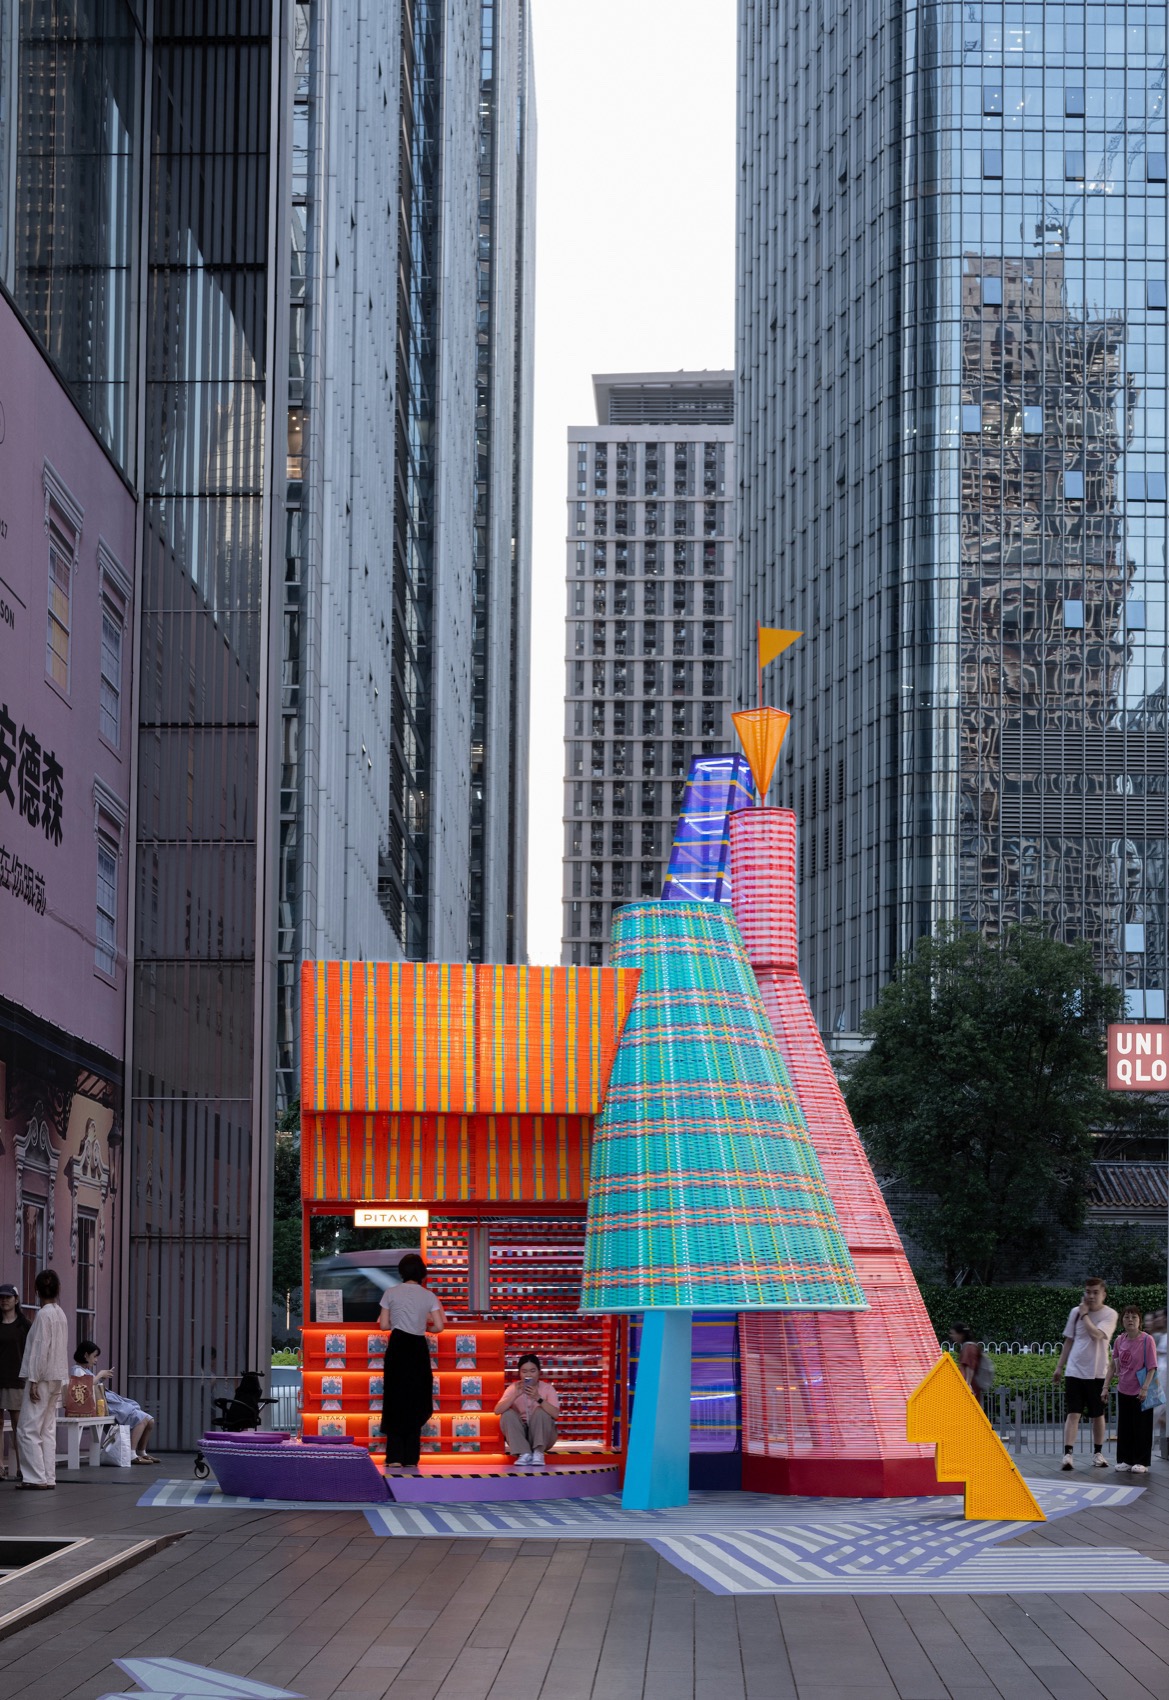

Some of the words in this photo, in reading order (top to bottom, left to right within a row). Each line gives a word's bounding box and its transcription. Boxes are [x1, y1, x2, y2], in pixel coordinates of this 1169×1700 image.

[0, 518, 8, 540] 17
[0, 703, 64, 848] 安德森
[0, 844, 47, 917] 在你眼前
[1116, 1032, 1163, 1055] UNI
[1116, 1059, 1168, 1085] QLO
[363, 1214, 419, 1222] PITAKA
